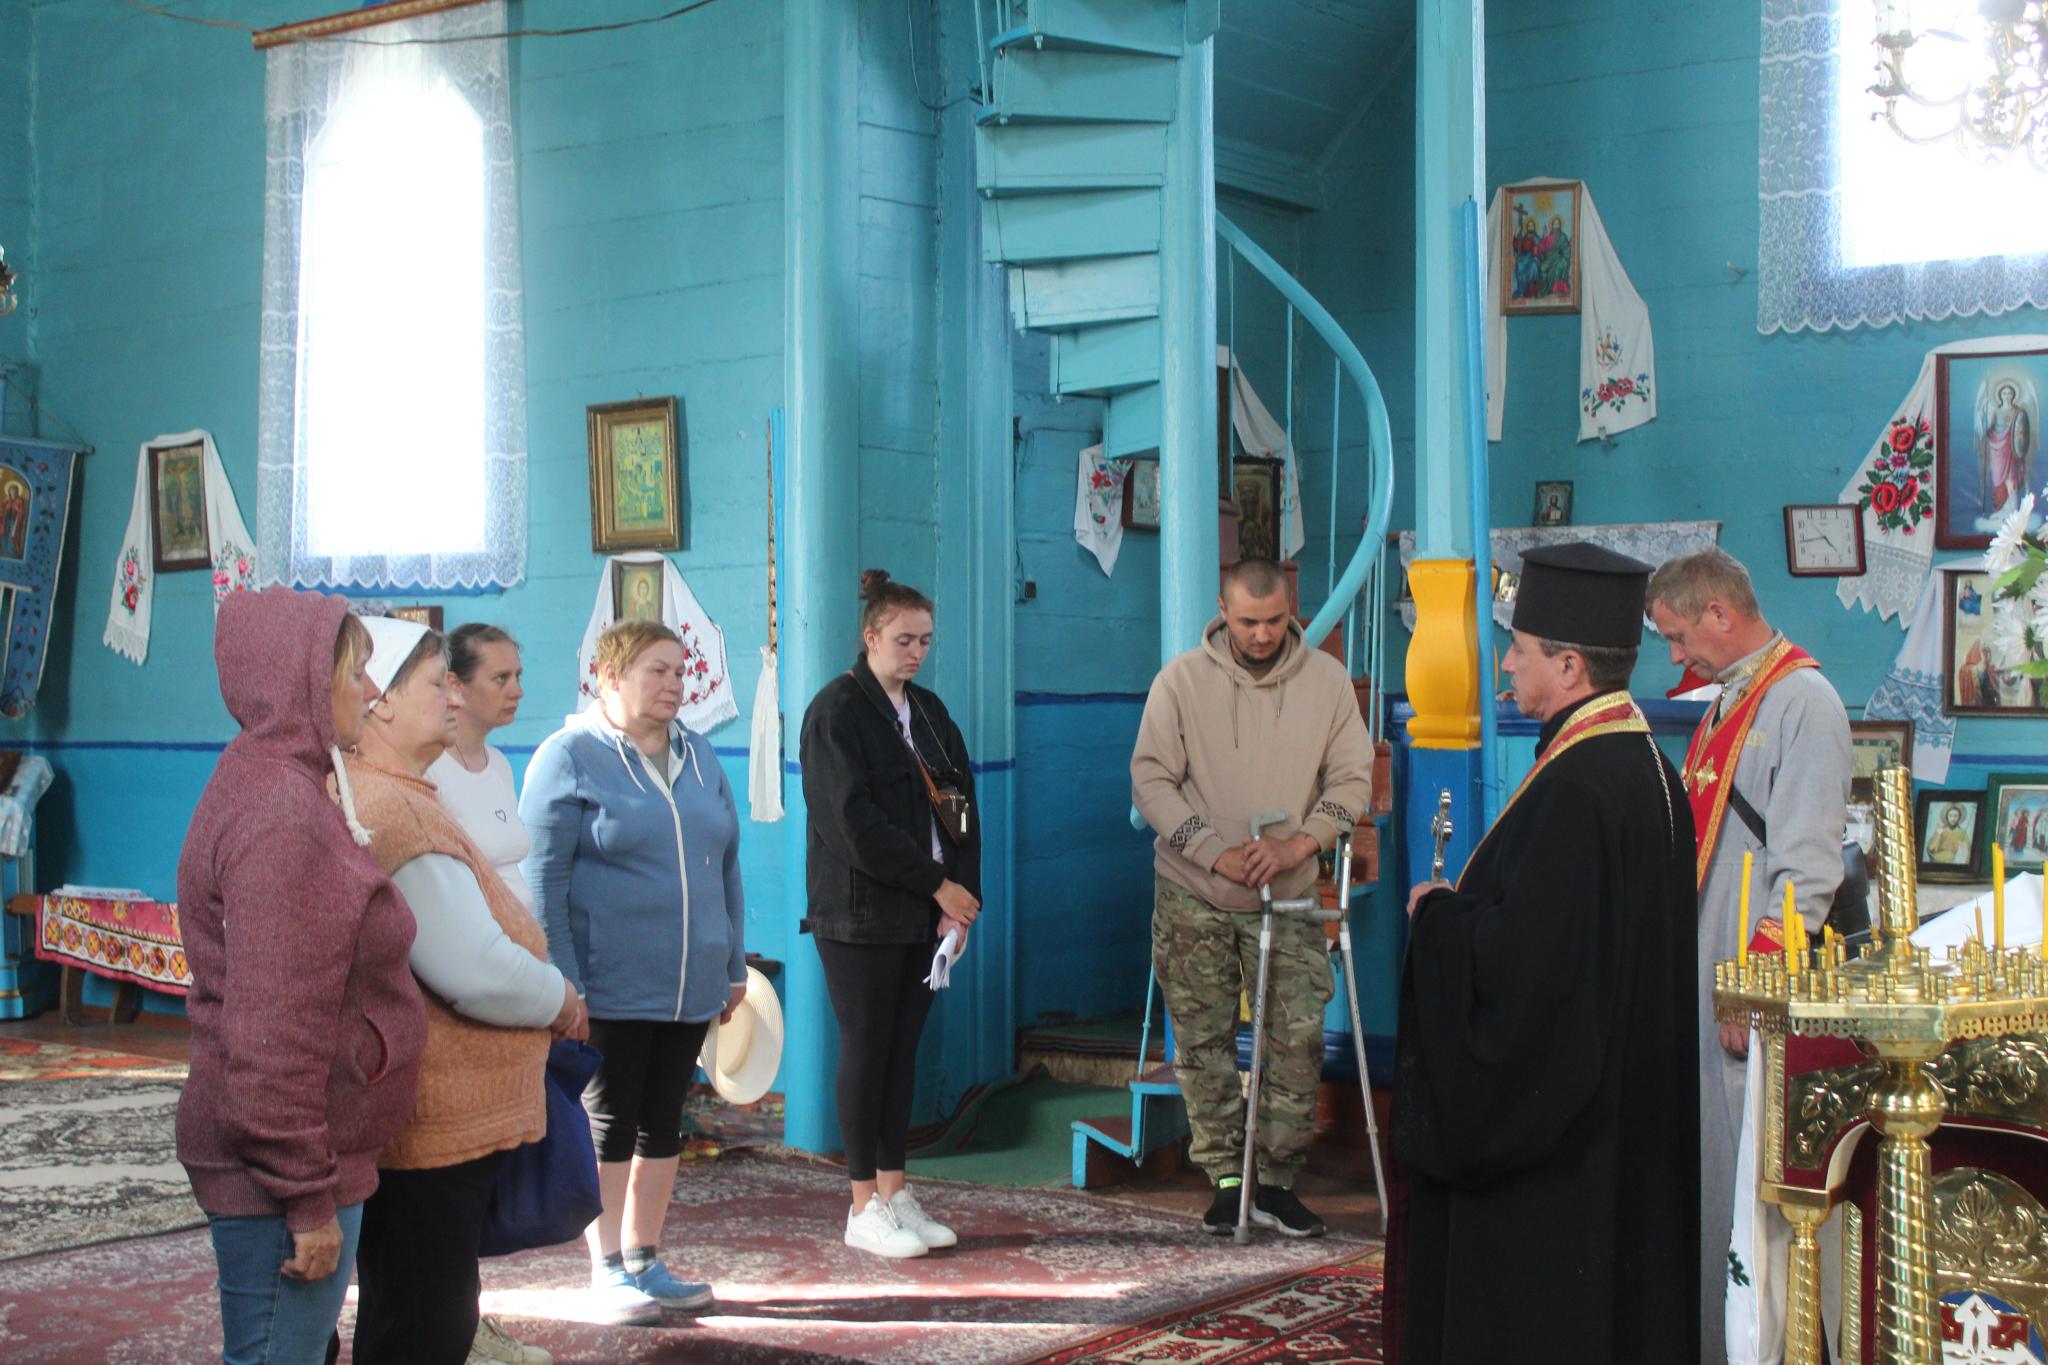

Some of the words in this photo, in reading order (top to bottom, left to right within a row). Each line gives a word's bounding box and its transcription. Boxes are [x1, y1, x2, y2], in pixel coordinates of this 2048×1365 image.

[1806, 509, 1813, 519] 11
[1820, 509, 1827, 519] 12
[1834, 509, 1839, 519] 1
[1843, 519, 1850, 529] 2
